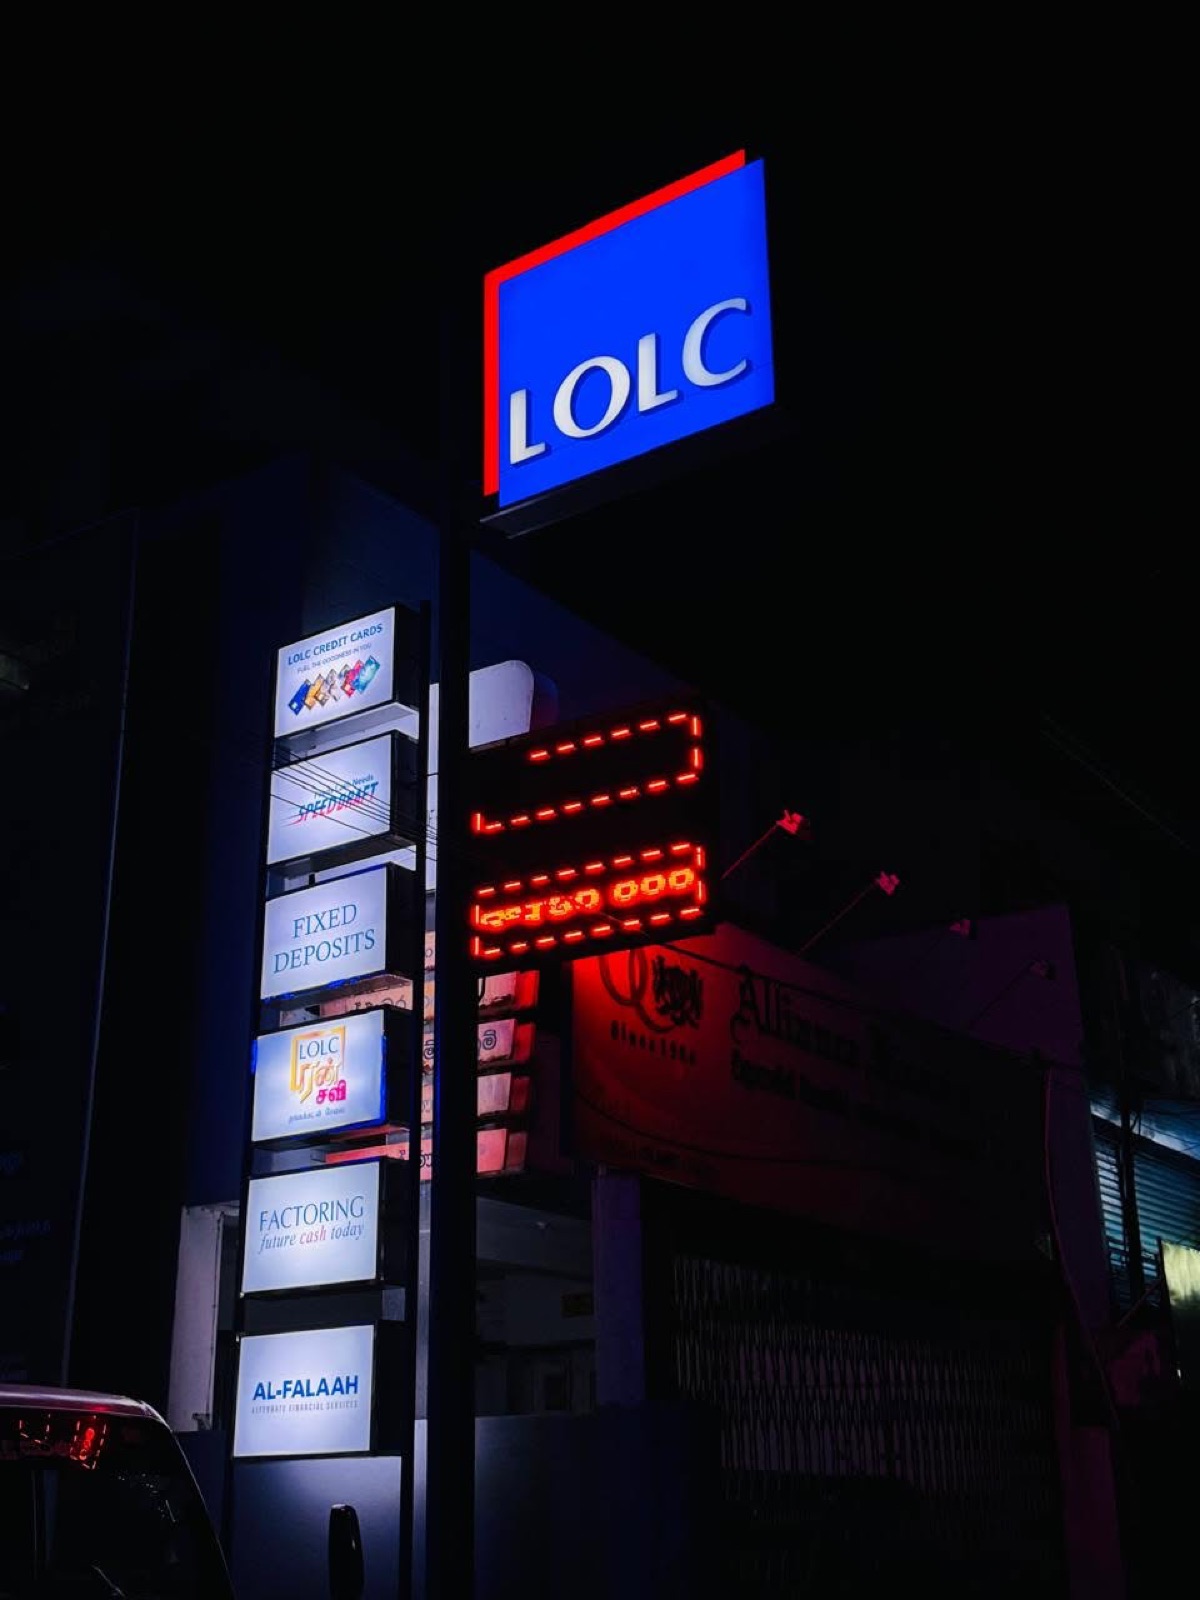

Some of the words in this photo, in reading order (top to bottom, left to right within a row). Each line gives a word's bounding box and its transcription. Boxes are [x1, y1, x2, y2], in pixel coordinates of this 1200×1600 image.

[509, 297, 749, 466] LOLC
[287, 649, 311, 666] LOLC
[313, 634, 348, 656] CREDIT
[350, 622, 383, 643] CARDS
[292, 903, 357, 939] FIXED
[273, 928, 376, 975] DEPOSITS
[299, 1036, 340, 1060] LOLC
[259, 1195, 365, 1232] FACTORING
[257, 1230, 296, 1254] future
[299, 1225, 327, 1246] cash
[330, 1220, 365, 1242] today
[252, 1375, 359, 1401] AL-FALAAH
